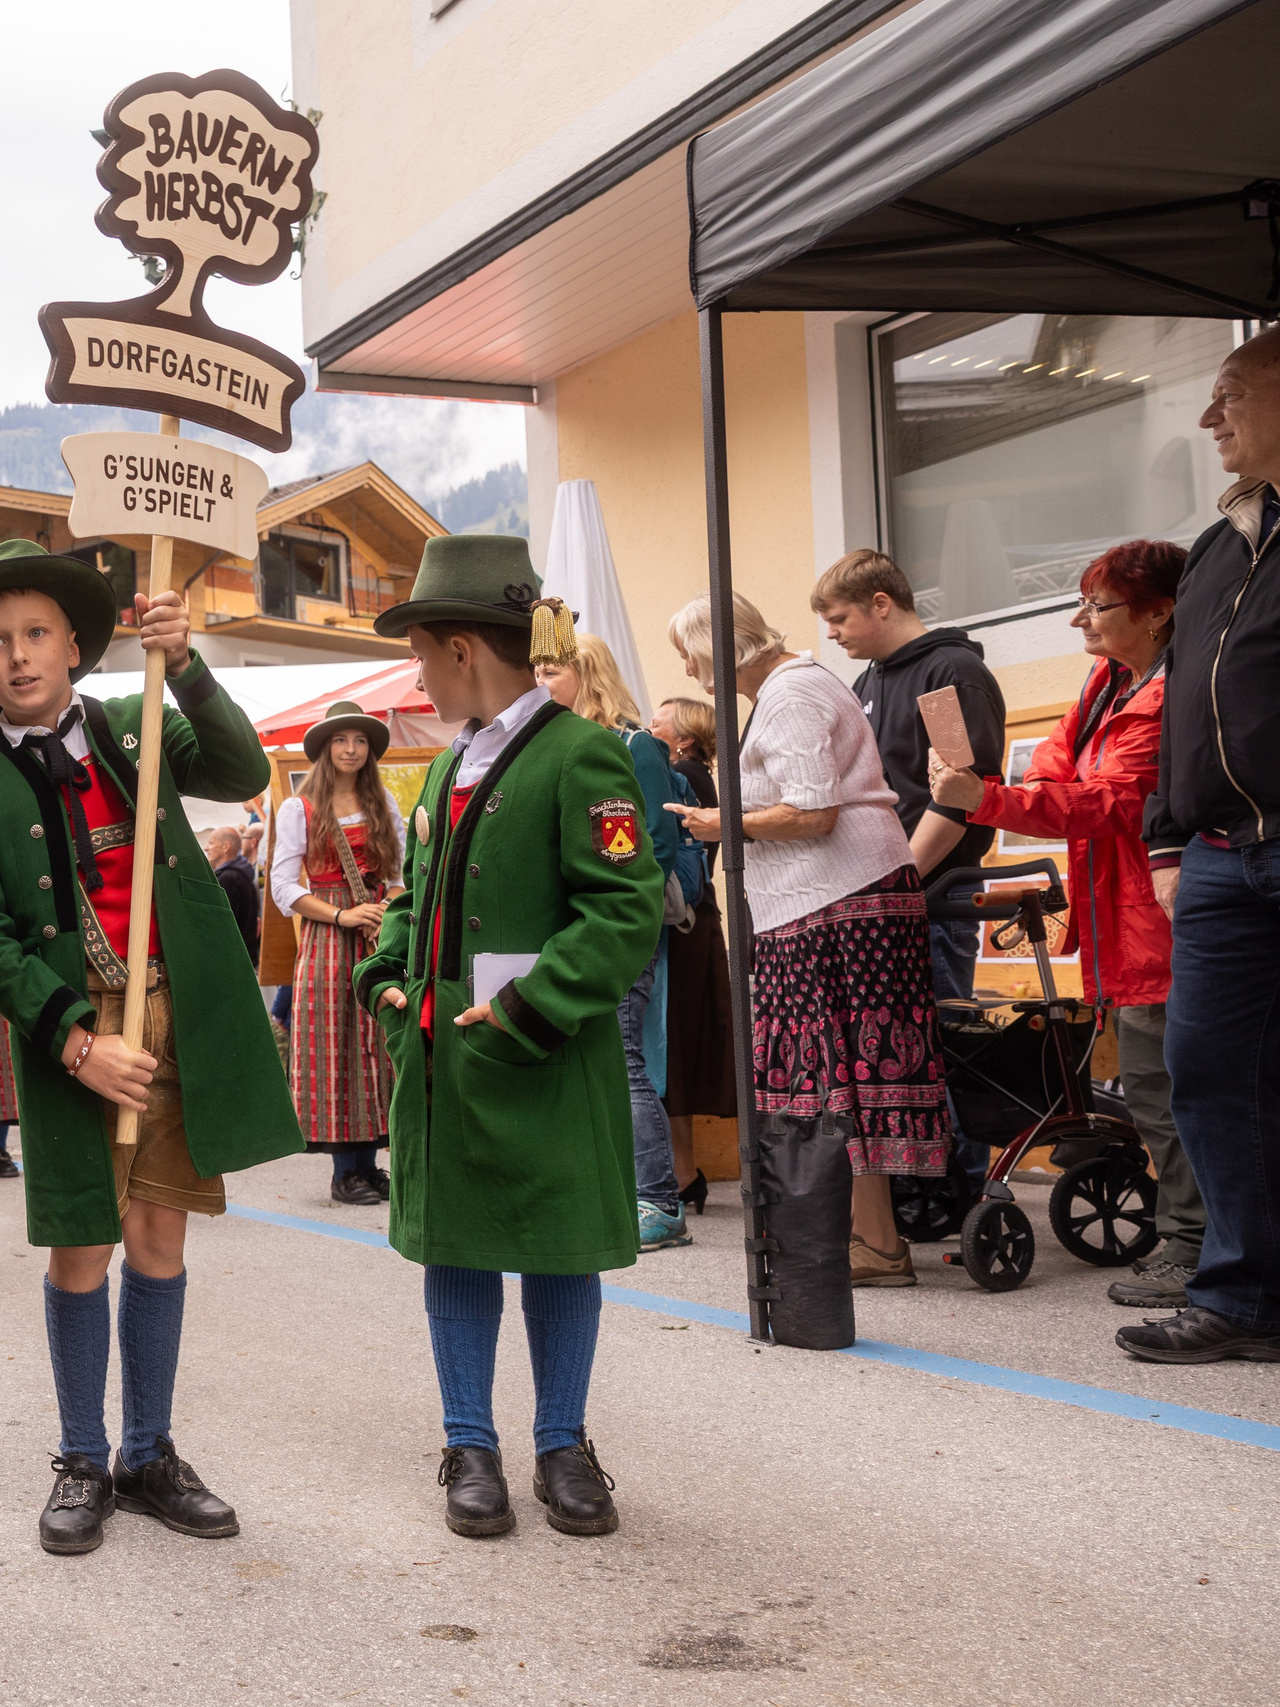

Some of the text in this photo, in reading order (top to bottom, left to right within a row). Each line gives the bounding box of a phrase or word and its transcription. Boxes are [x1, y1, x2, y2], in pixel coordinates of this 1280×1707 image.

[145, 110, 294, 196] BAUERN
[144, 170, 275, 246] HERBST
[86, 336, 271, 411] DORFGASTEIN
[103, 454, 234, 500] G'SUNGEN &
[122, 484, 217, 524] G'SPIELT
